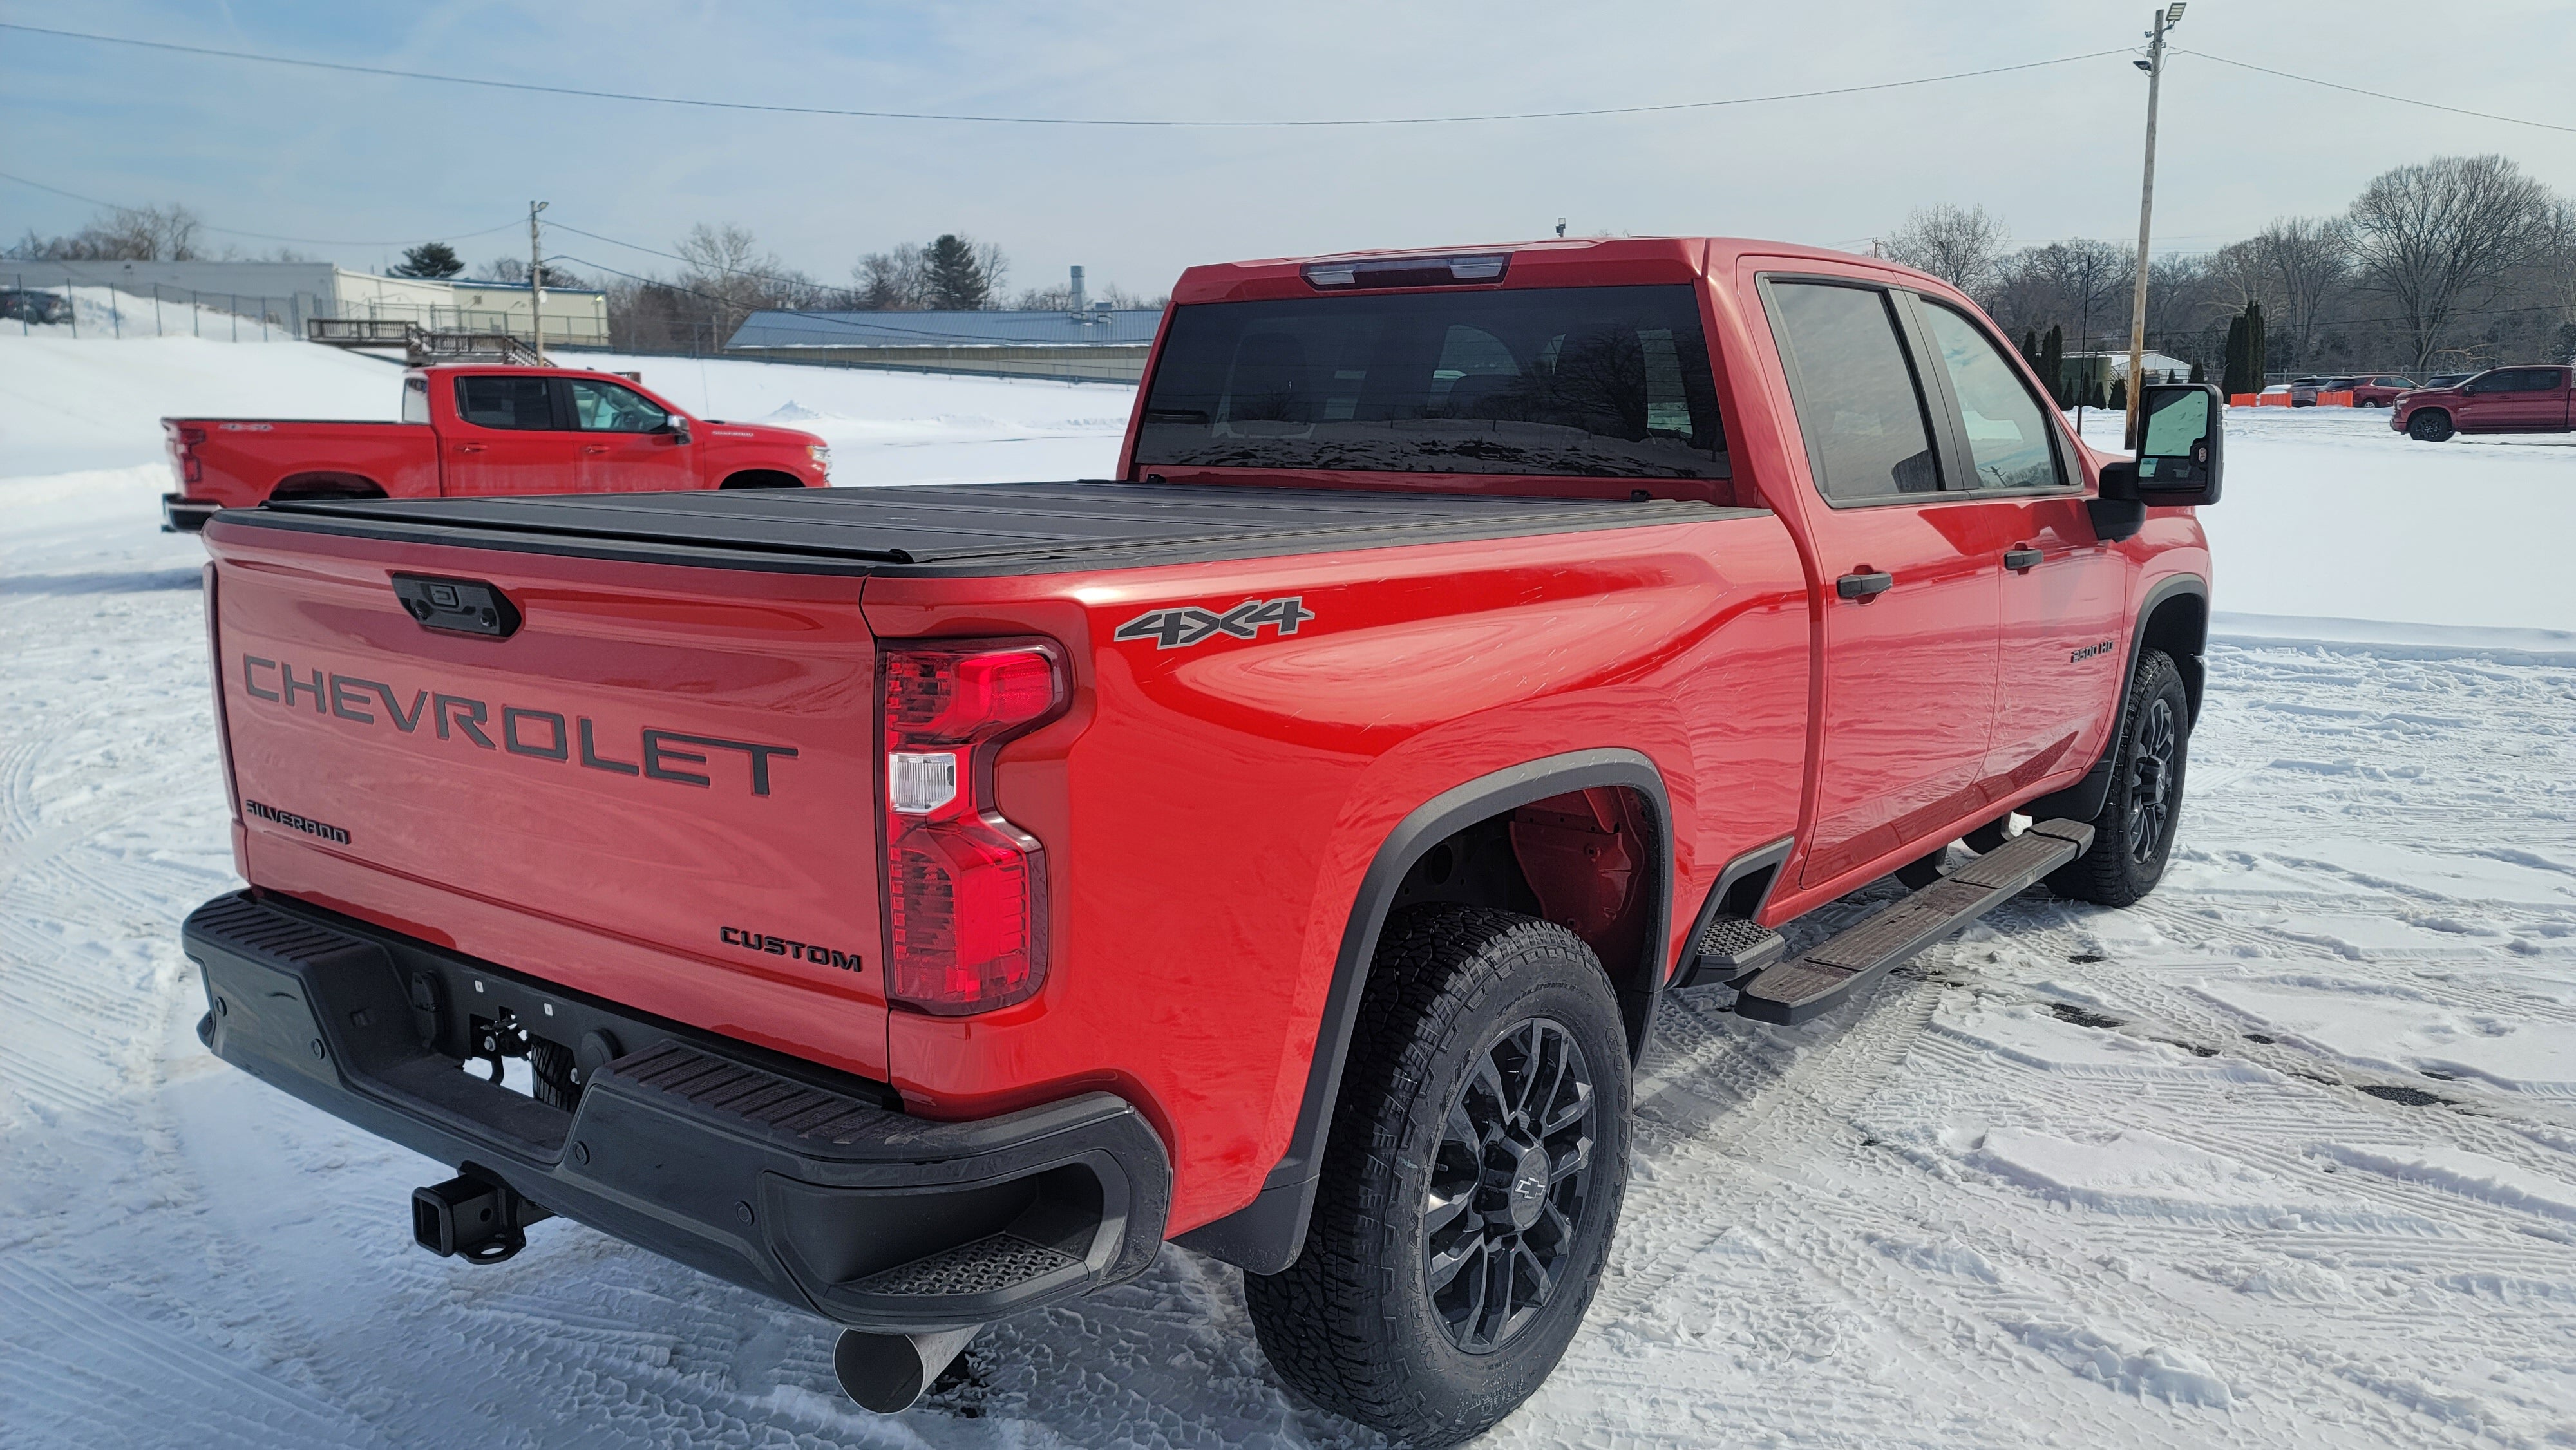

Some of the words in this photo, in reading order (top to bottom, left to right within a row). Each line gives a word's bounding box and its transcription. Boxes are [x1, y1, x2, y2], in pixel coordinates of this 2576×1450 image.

[2070, 645, 2098, 663] 2500
[2099, 641, 2114, 654] HD
[244, 654, 799, 797] CHEVROLET
[245, 799, 352, 845] SILVERADO
[721, 926, 864, 973] CUSTOM
